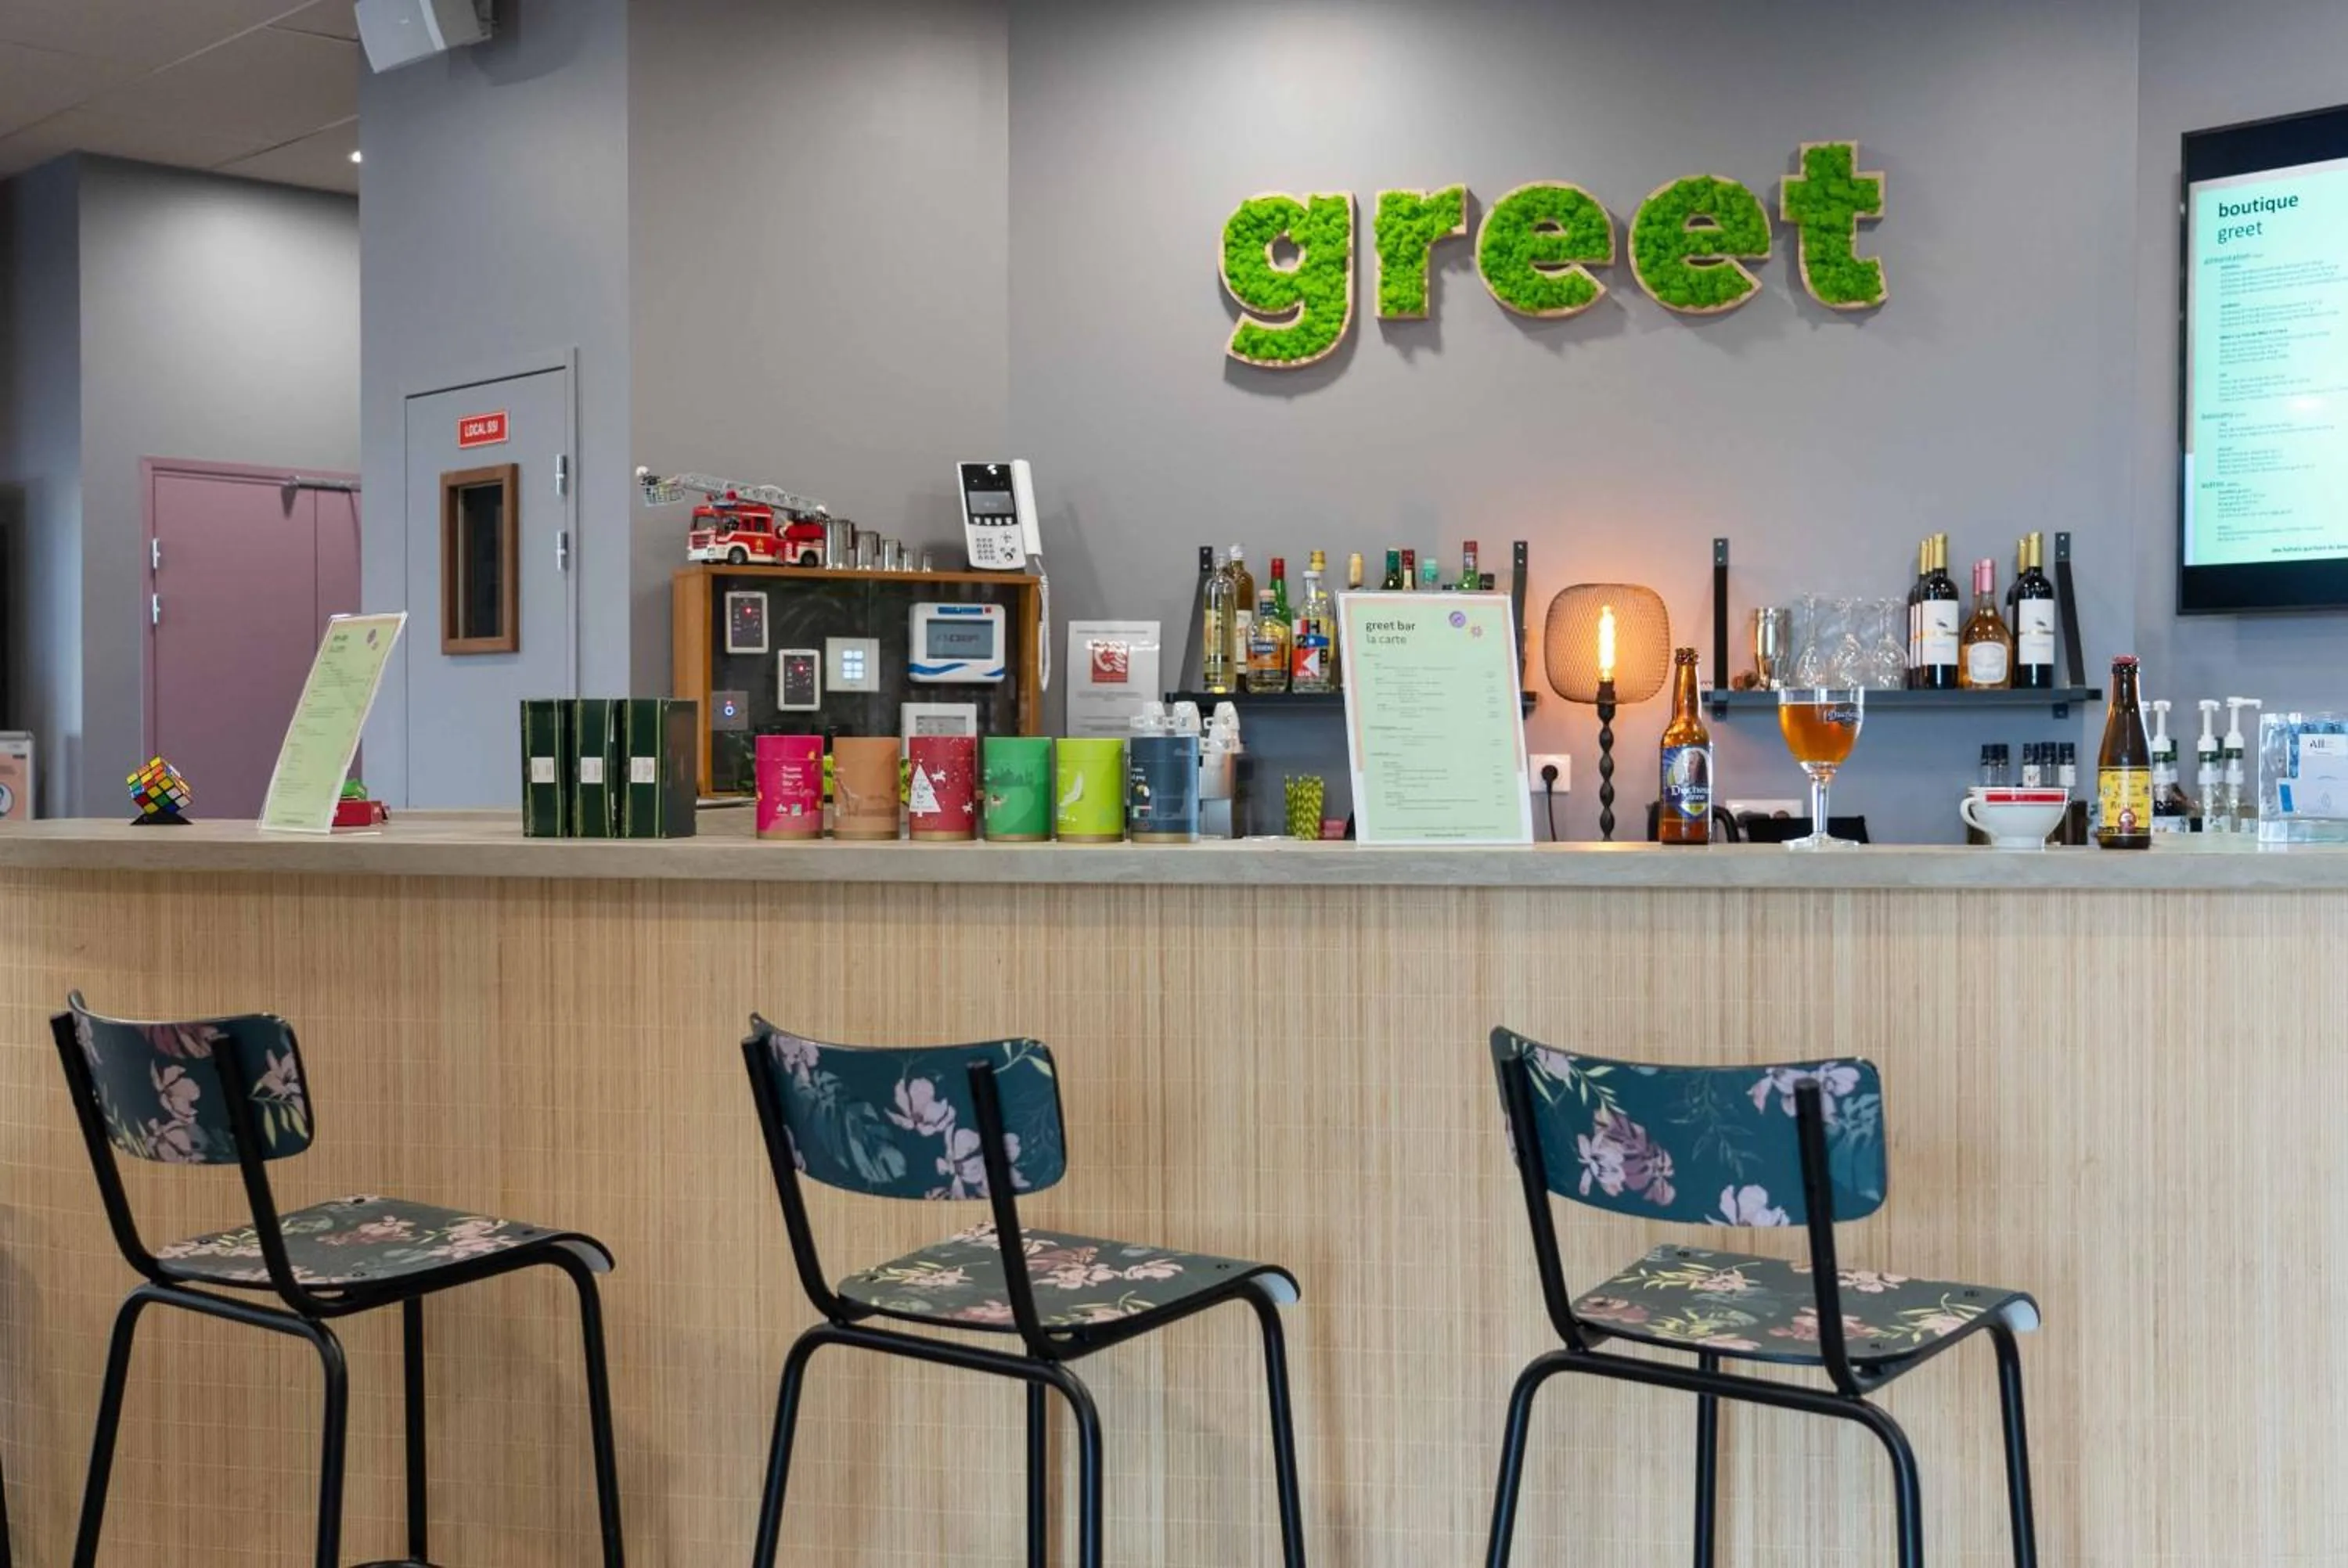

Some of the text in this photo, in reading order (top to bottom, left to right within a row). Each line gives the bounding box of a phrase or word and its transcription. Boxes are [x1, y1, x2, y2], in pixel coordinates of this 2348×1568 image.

[2219, 195, 2299, 218] boutique
[2217, 221, 2262, 244] greet
[1218, 139, 1889, 368] greet
[464, 423, 486, 438] LOCAL
[1366, 619, 1415, 632] greet bar
[1366, 634, 1377, 644] la
